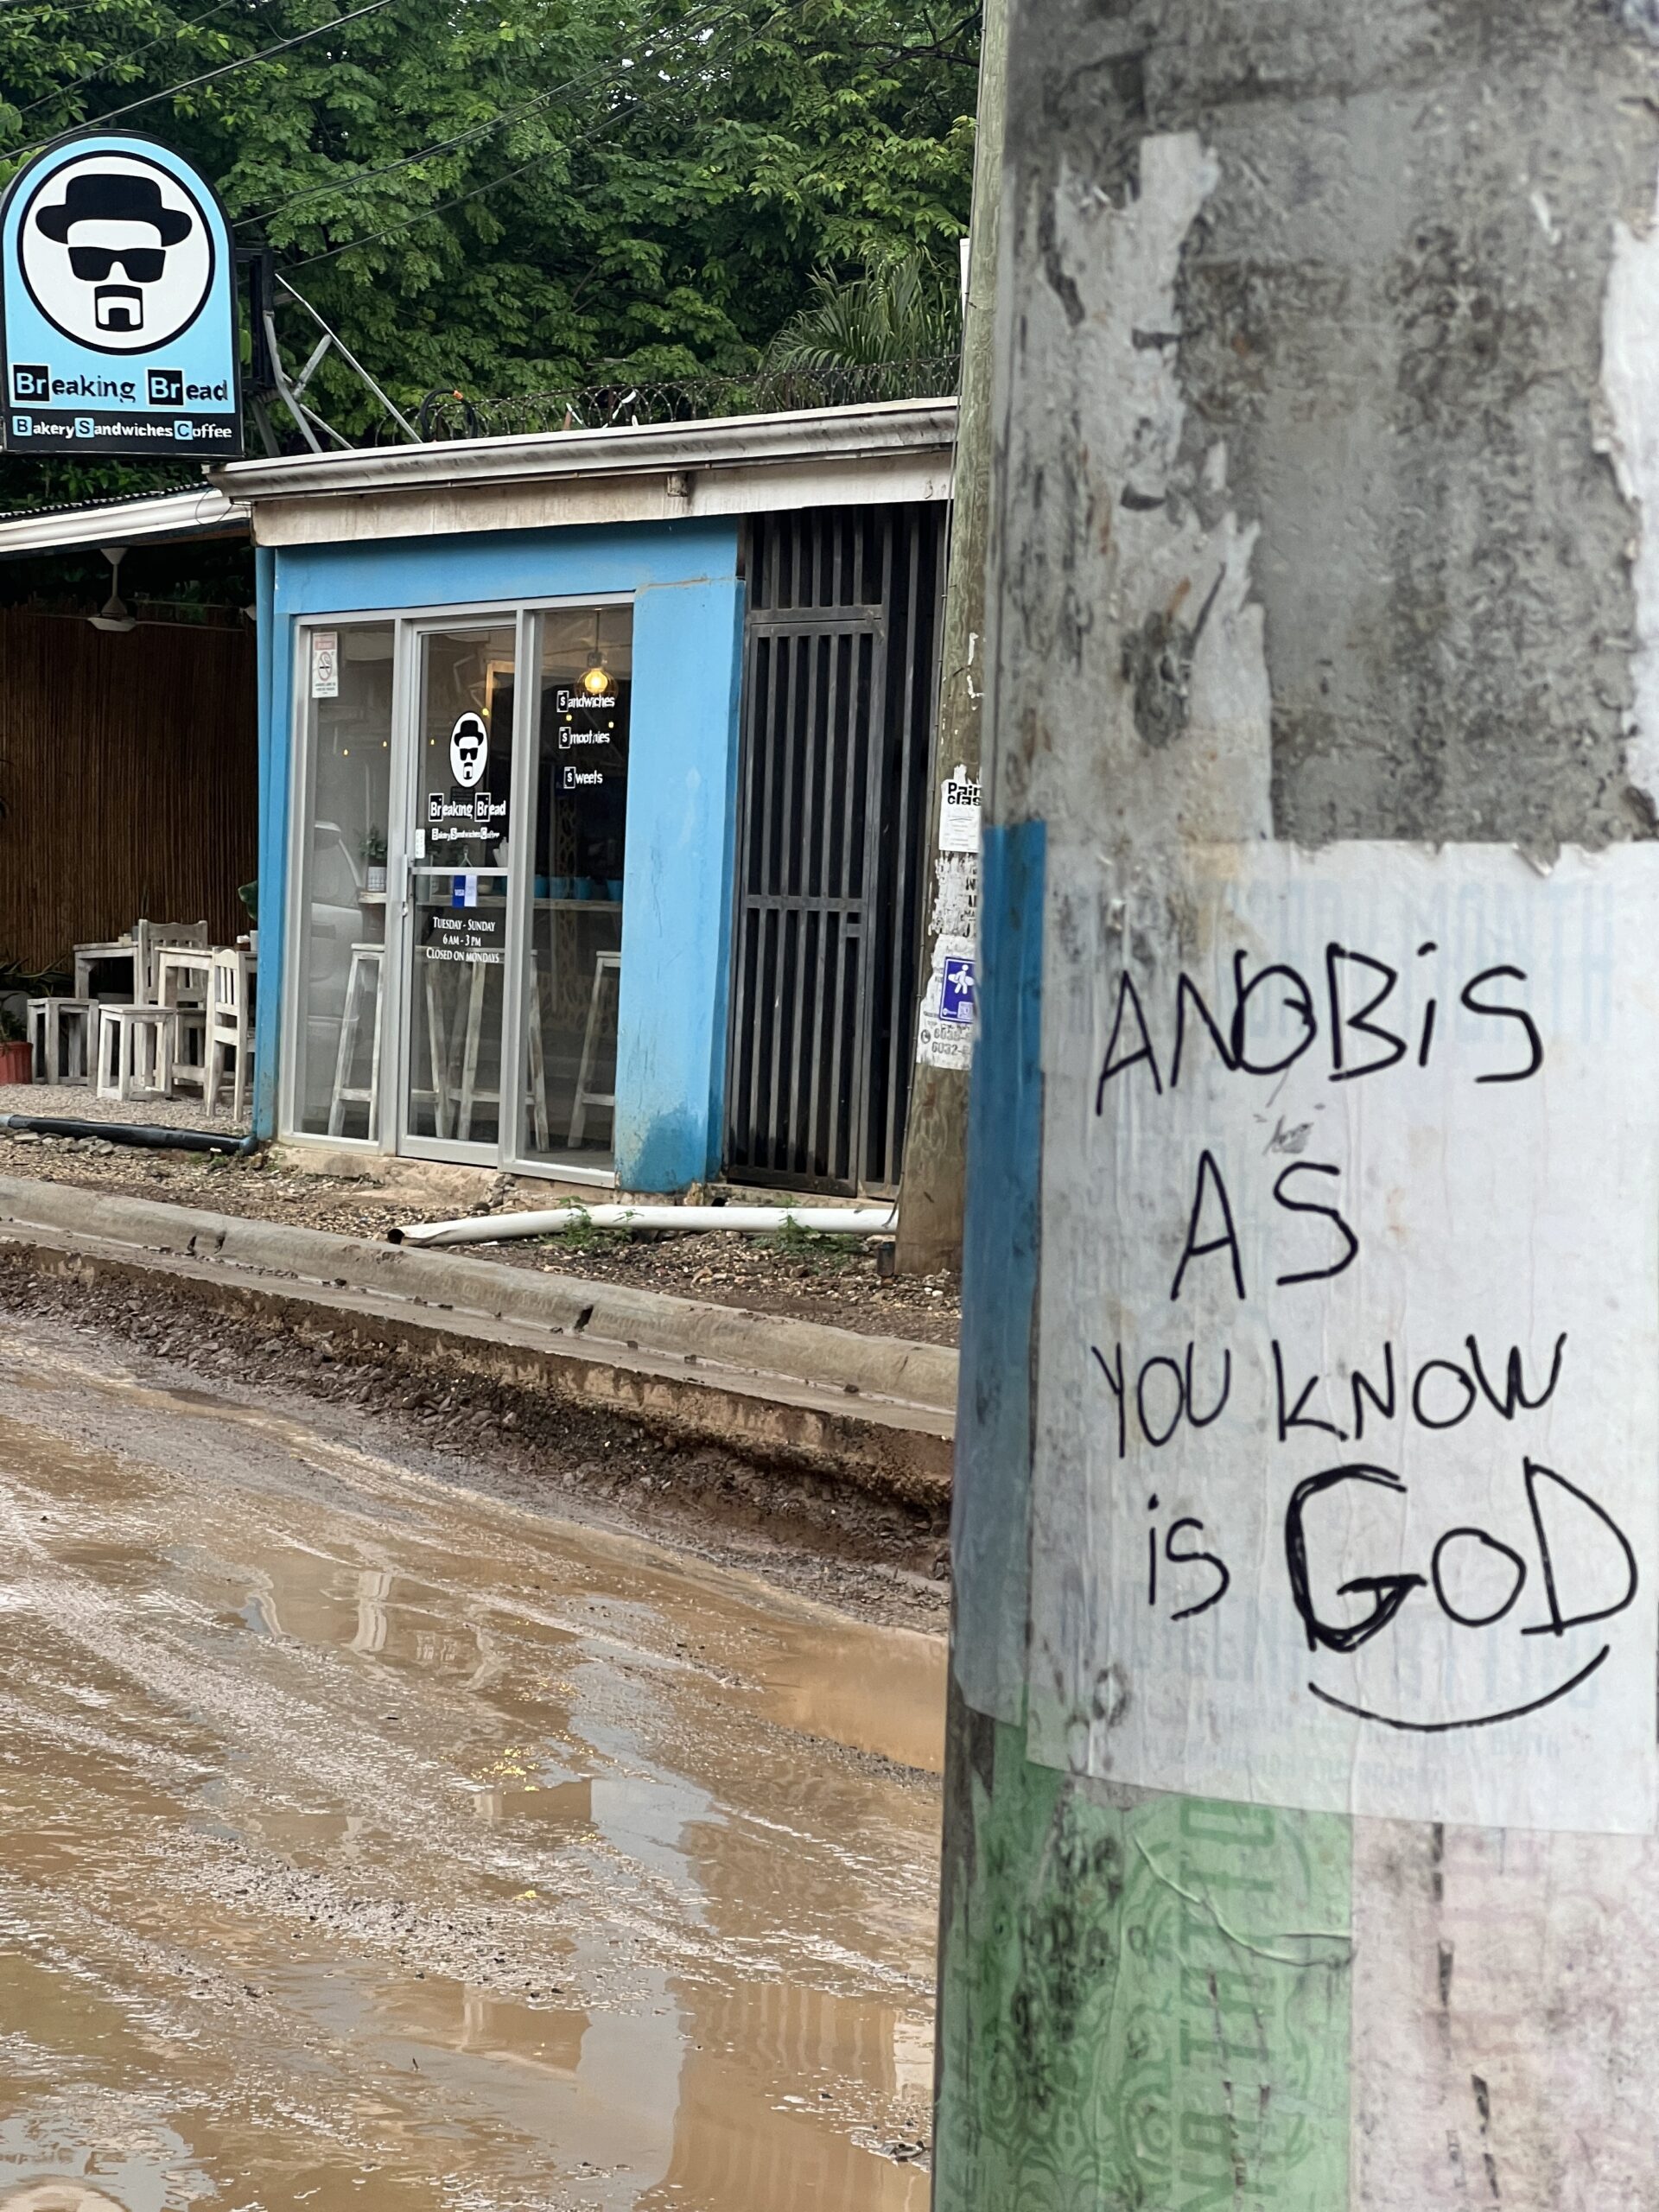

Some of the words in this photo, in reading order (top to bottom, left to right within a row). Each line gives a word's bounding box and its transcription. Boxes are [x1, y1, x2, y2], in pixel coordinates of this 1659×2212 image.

[15, 371, 136, 404] Breaking
[149, 376, 229, 403] Bread
[14, 417, 74, 439] Bakery
[77, 419, 173, 438] Sandwiches
[176, 422, 232, 439] Coffee
[558, 691, 615, 709] Sandwiches
[561, 728, 610, 746] Smoothies
[566, 769, 603, 785] Sweets
[429, 798, 474, 820] Breaking
[476, 798, 506, 817] Bread
[432, 917, 462, 931] TUESDAY
[467, 919, 496, 931] SUNDAY
[426, 947, 453, 960] CLOSED
[454, 950, 465, 961] ON
[466, 952, 499, 963] MONDAYS
[1170, 1149, 1361, 1300] AS
[1091, 1344, 1232, 1459] YOU
